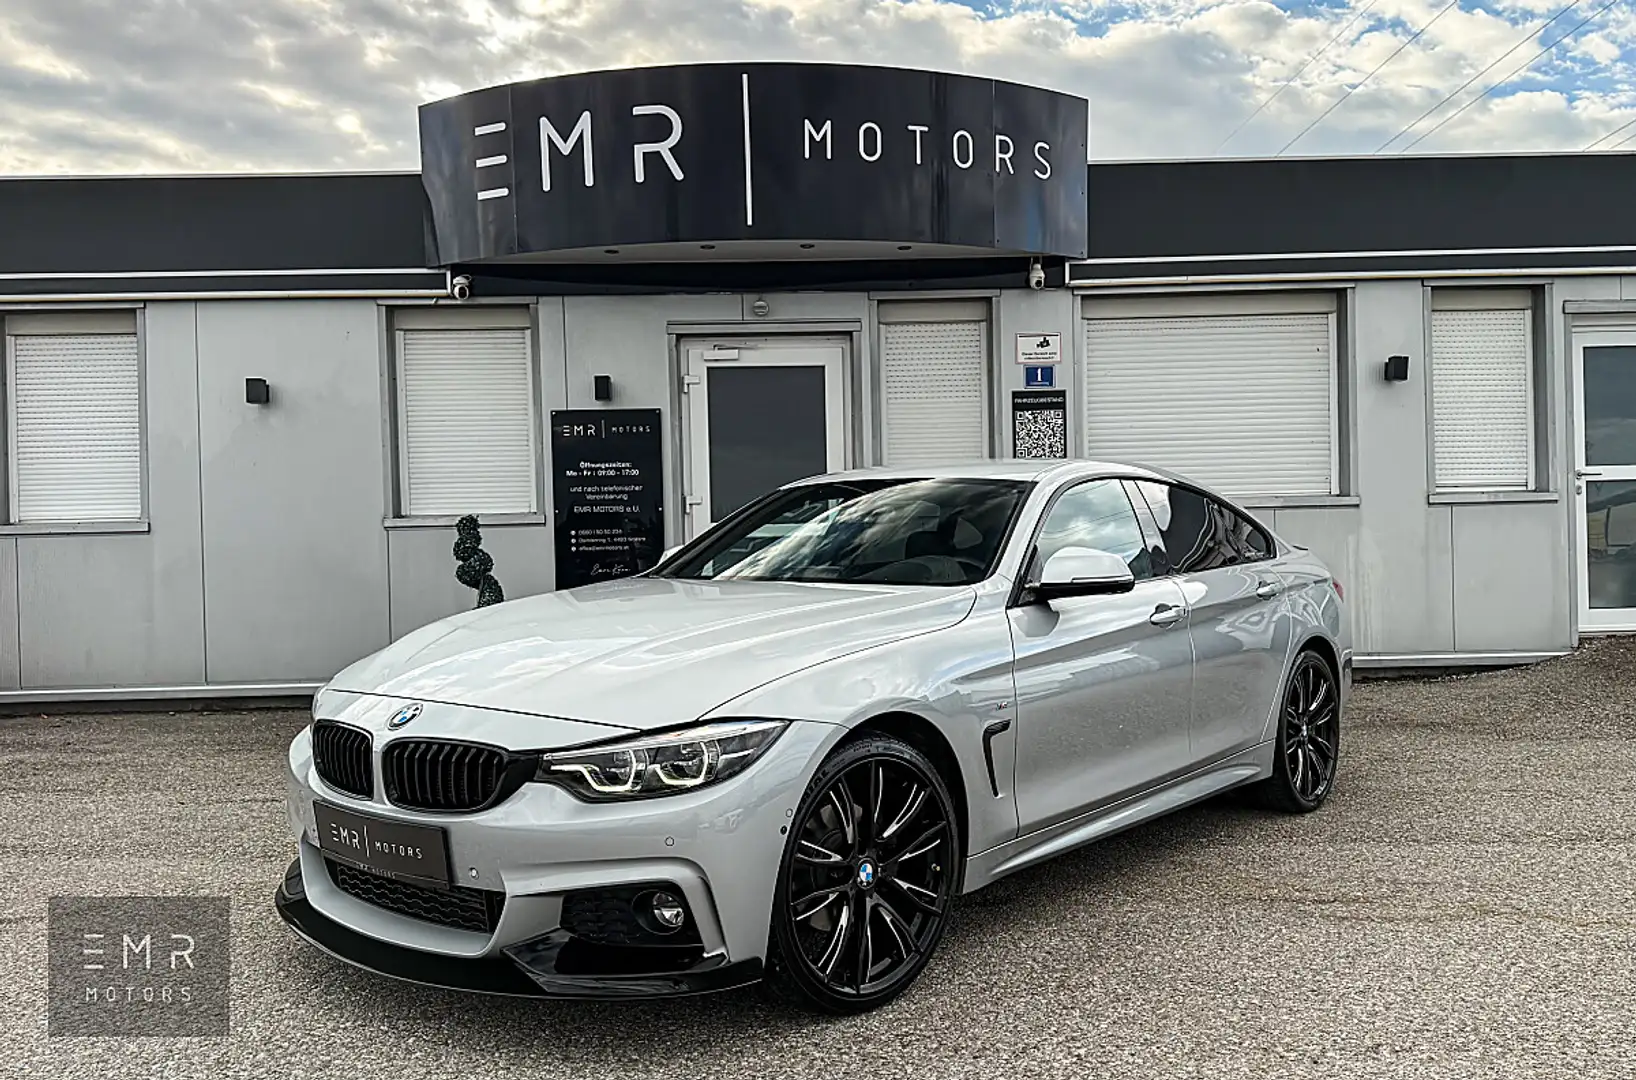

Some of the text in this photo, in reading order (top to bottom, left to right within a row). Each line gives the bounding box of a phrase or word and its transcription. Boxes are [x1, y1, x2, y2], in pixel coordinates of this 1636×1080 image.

[474, 104, 1052, 201] EMR MOTORS
[1037, 367, 1042, 382] 1
[563, 424, 651, 437] EMR MOTORS
[569, 485, 583, 493] und
[601, 484, 643, 492] telefonischer
[585, 493, 629, 501] Vereinbarung
[573, 505, 592, 513] EMR
[593, 505, 625, 513] MOTORS
[330, 823, 423, 859] EMR MOTORS
